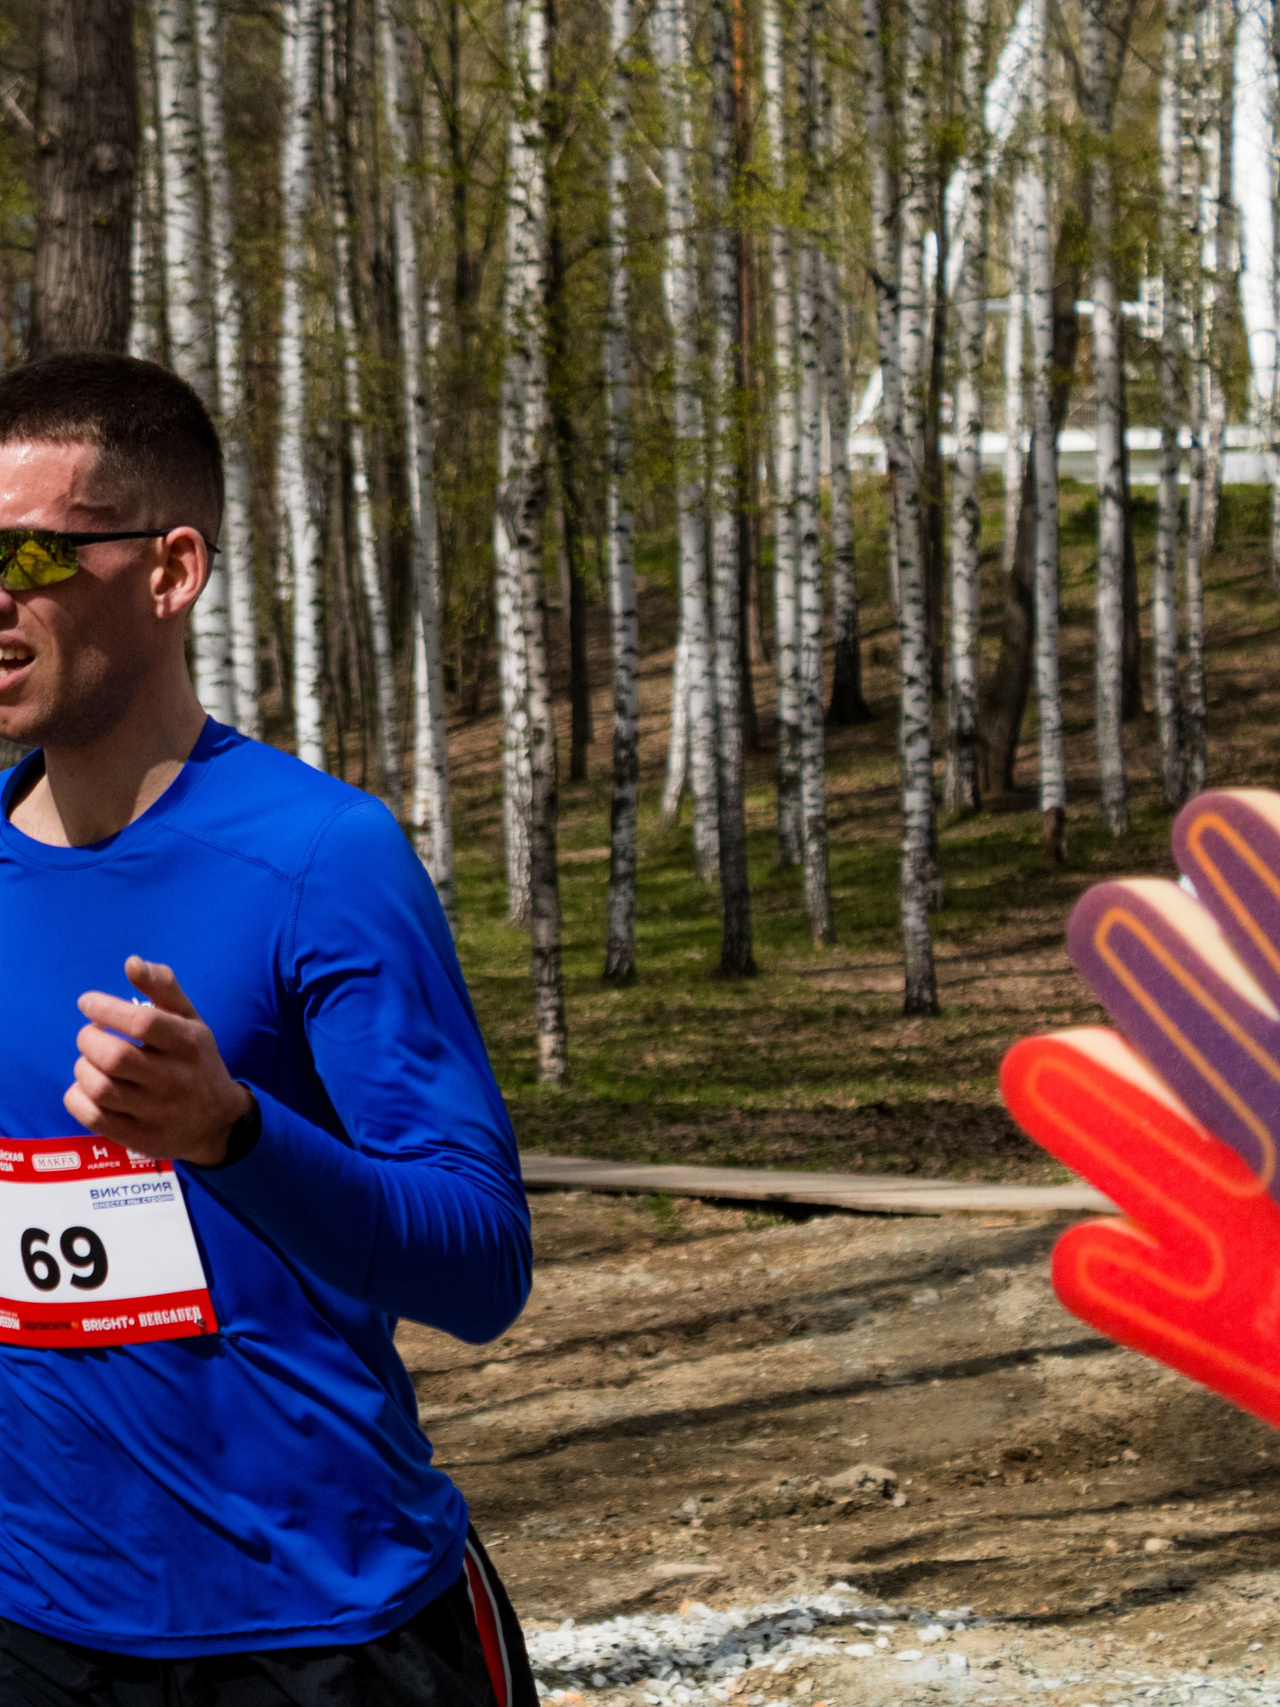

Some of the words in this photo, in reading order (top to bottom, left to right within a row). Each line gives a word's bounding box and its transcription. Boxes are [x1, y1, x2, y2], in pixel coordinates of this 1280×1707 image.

[87, 1161, 121, 1170] HARPER
[90, 1181, 173, 1200] ВИКТОРИЯ
[20, 1225, 109, 1293] 69
